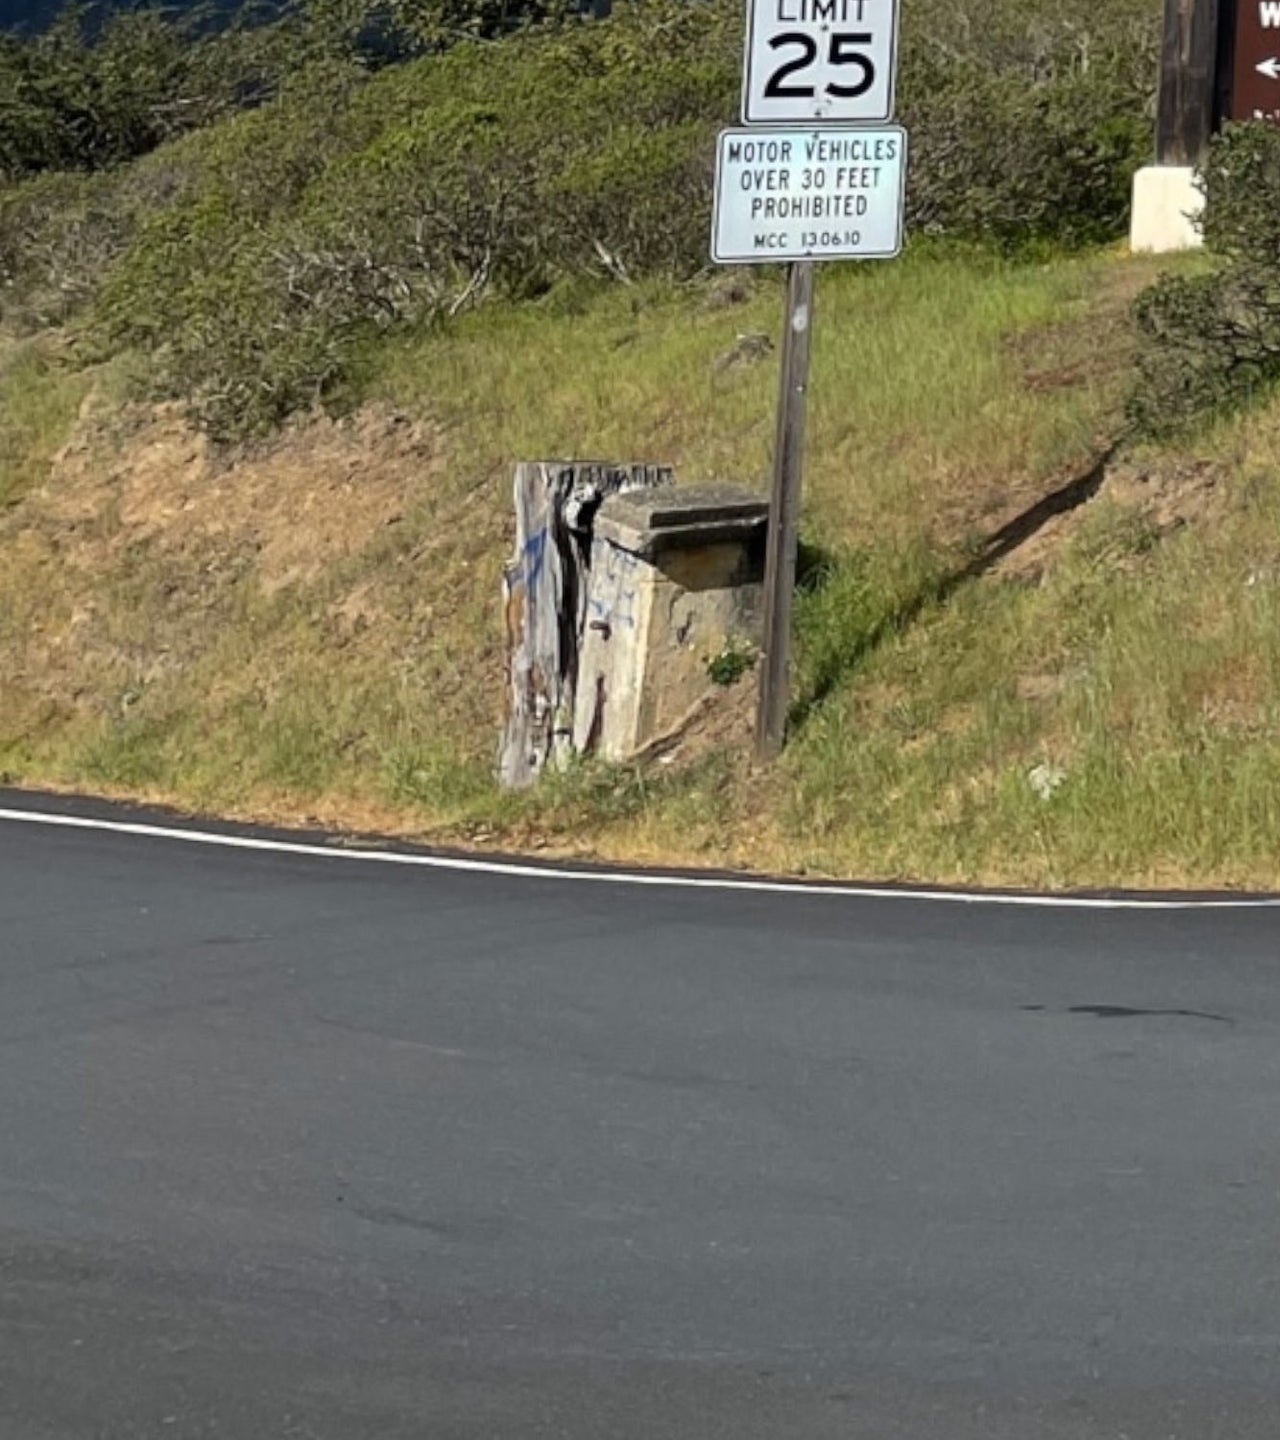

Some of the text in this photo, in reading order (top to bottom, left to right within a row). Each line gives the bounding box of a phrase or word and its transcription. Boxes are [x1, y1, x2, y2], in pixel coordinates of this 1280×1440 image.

[763, 32, 875, 99] 25
[728, 139, 897, 164] MOTOR VEHICLES
[740, 167, 882, 192] OVER 30 FEET
[751, 195, 868, 220] PROHIBITED
[754, 232, 788, 249] MCC
